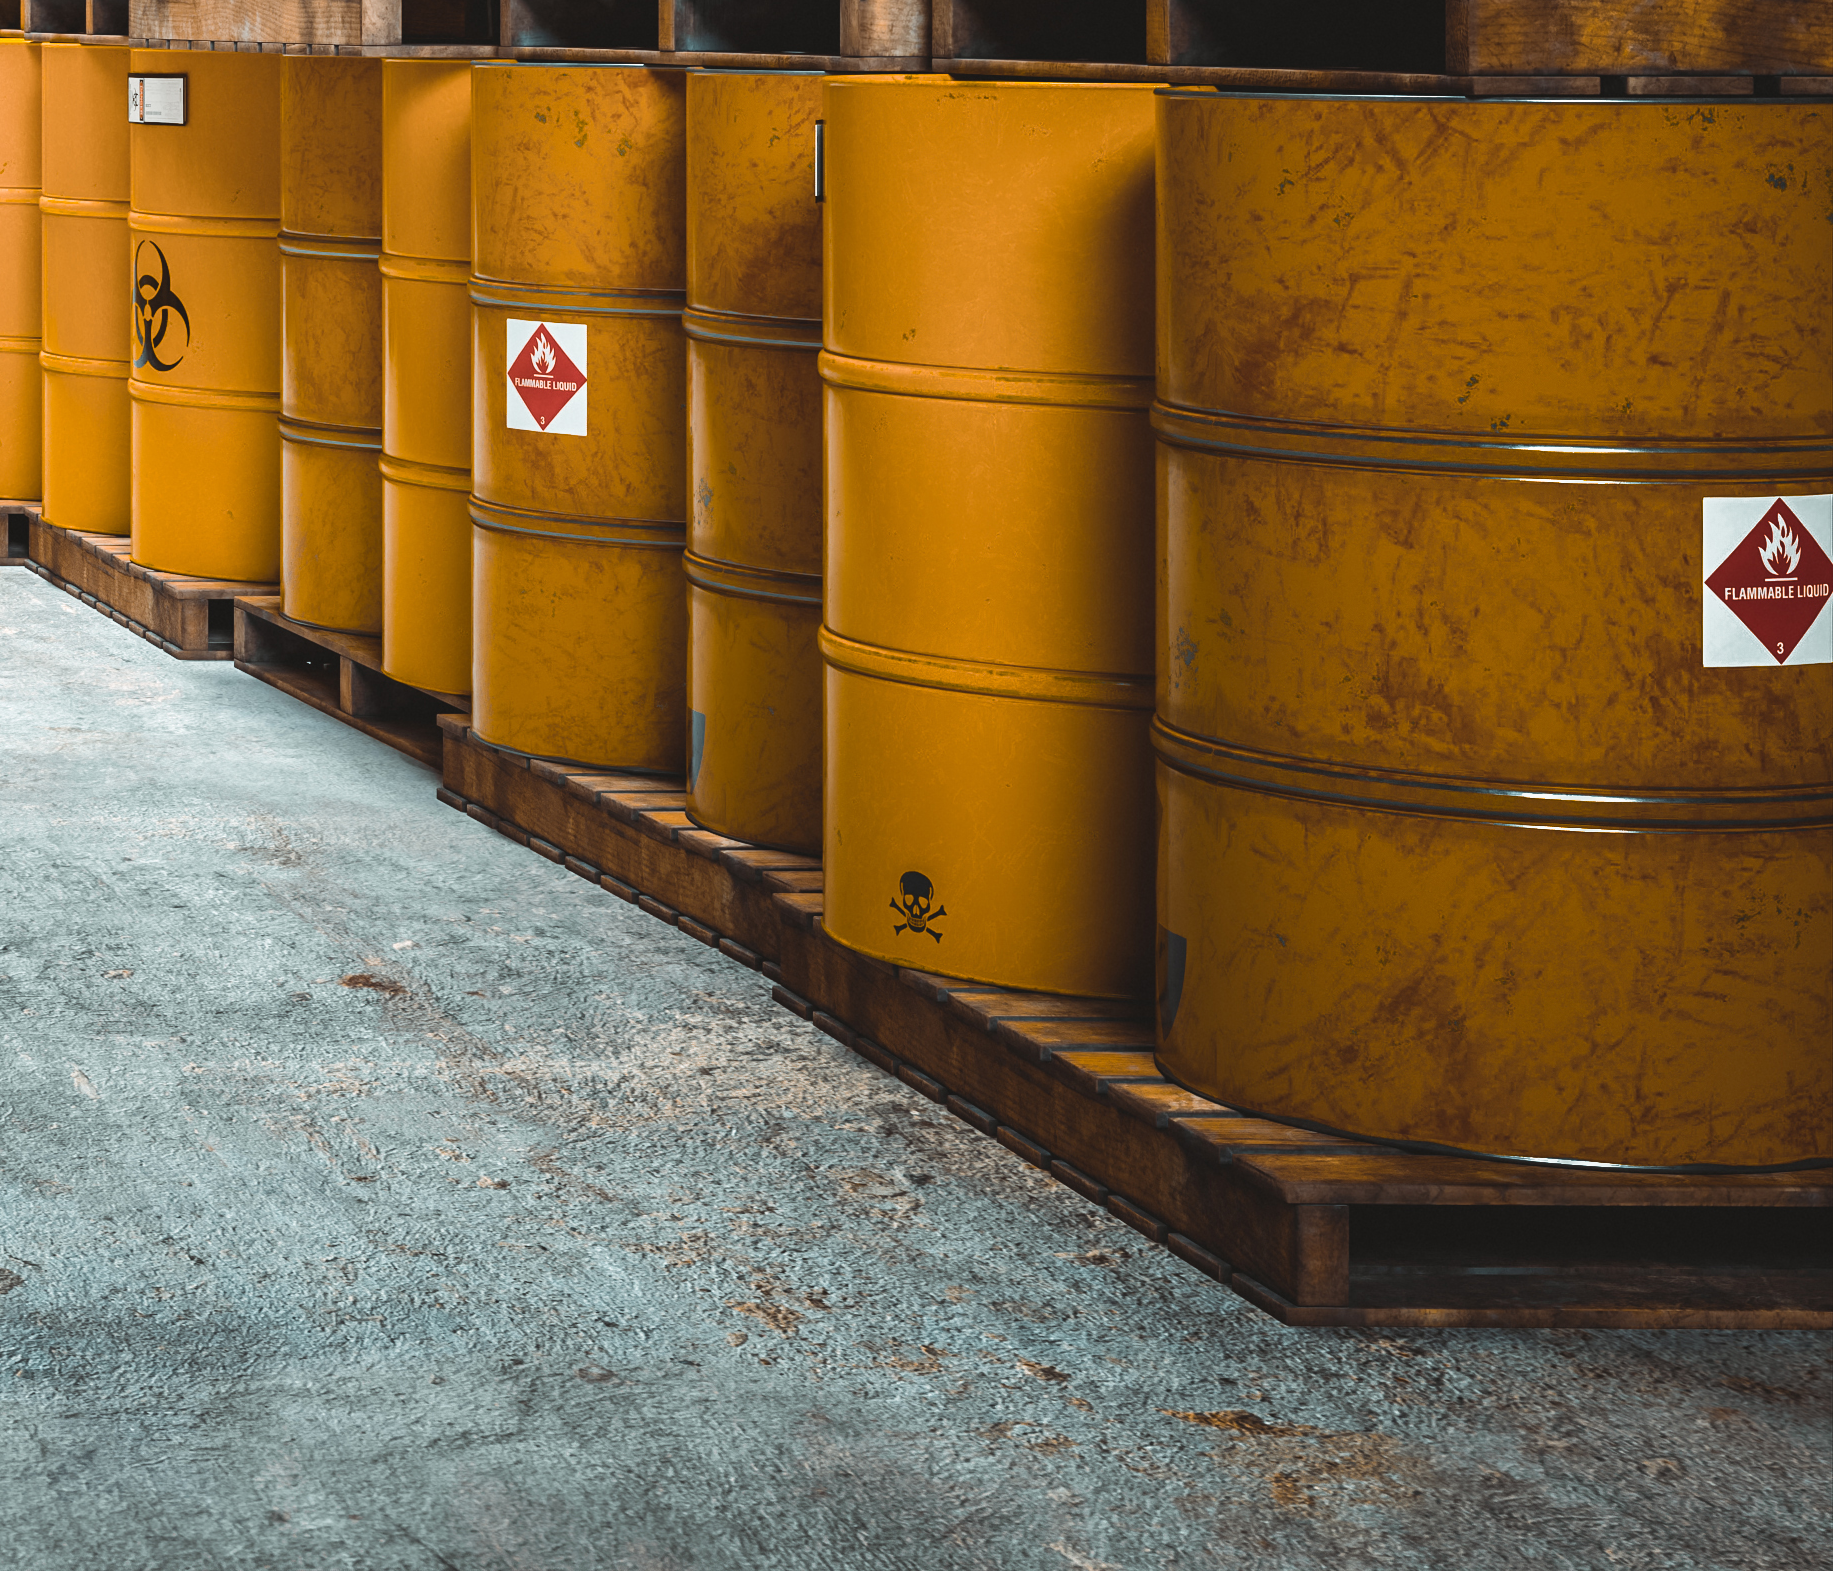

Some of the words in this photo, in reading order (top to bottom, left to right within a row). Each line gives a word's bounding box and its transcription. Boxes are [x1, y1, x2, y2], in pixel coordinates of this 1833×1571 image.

[515, 377, 552, 390] FLAMMABLE
[553, 380, 577, 391] LIQUID
[540, 417, 546, 425] 3
[1725, 586, 1794, 601] FLAMMABLE
[1798, 584, 1830, 598] LIQUID
[1777, 642, 1785, 655] 3
